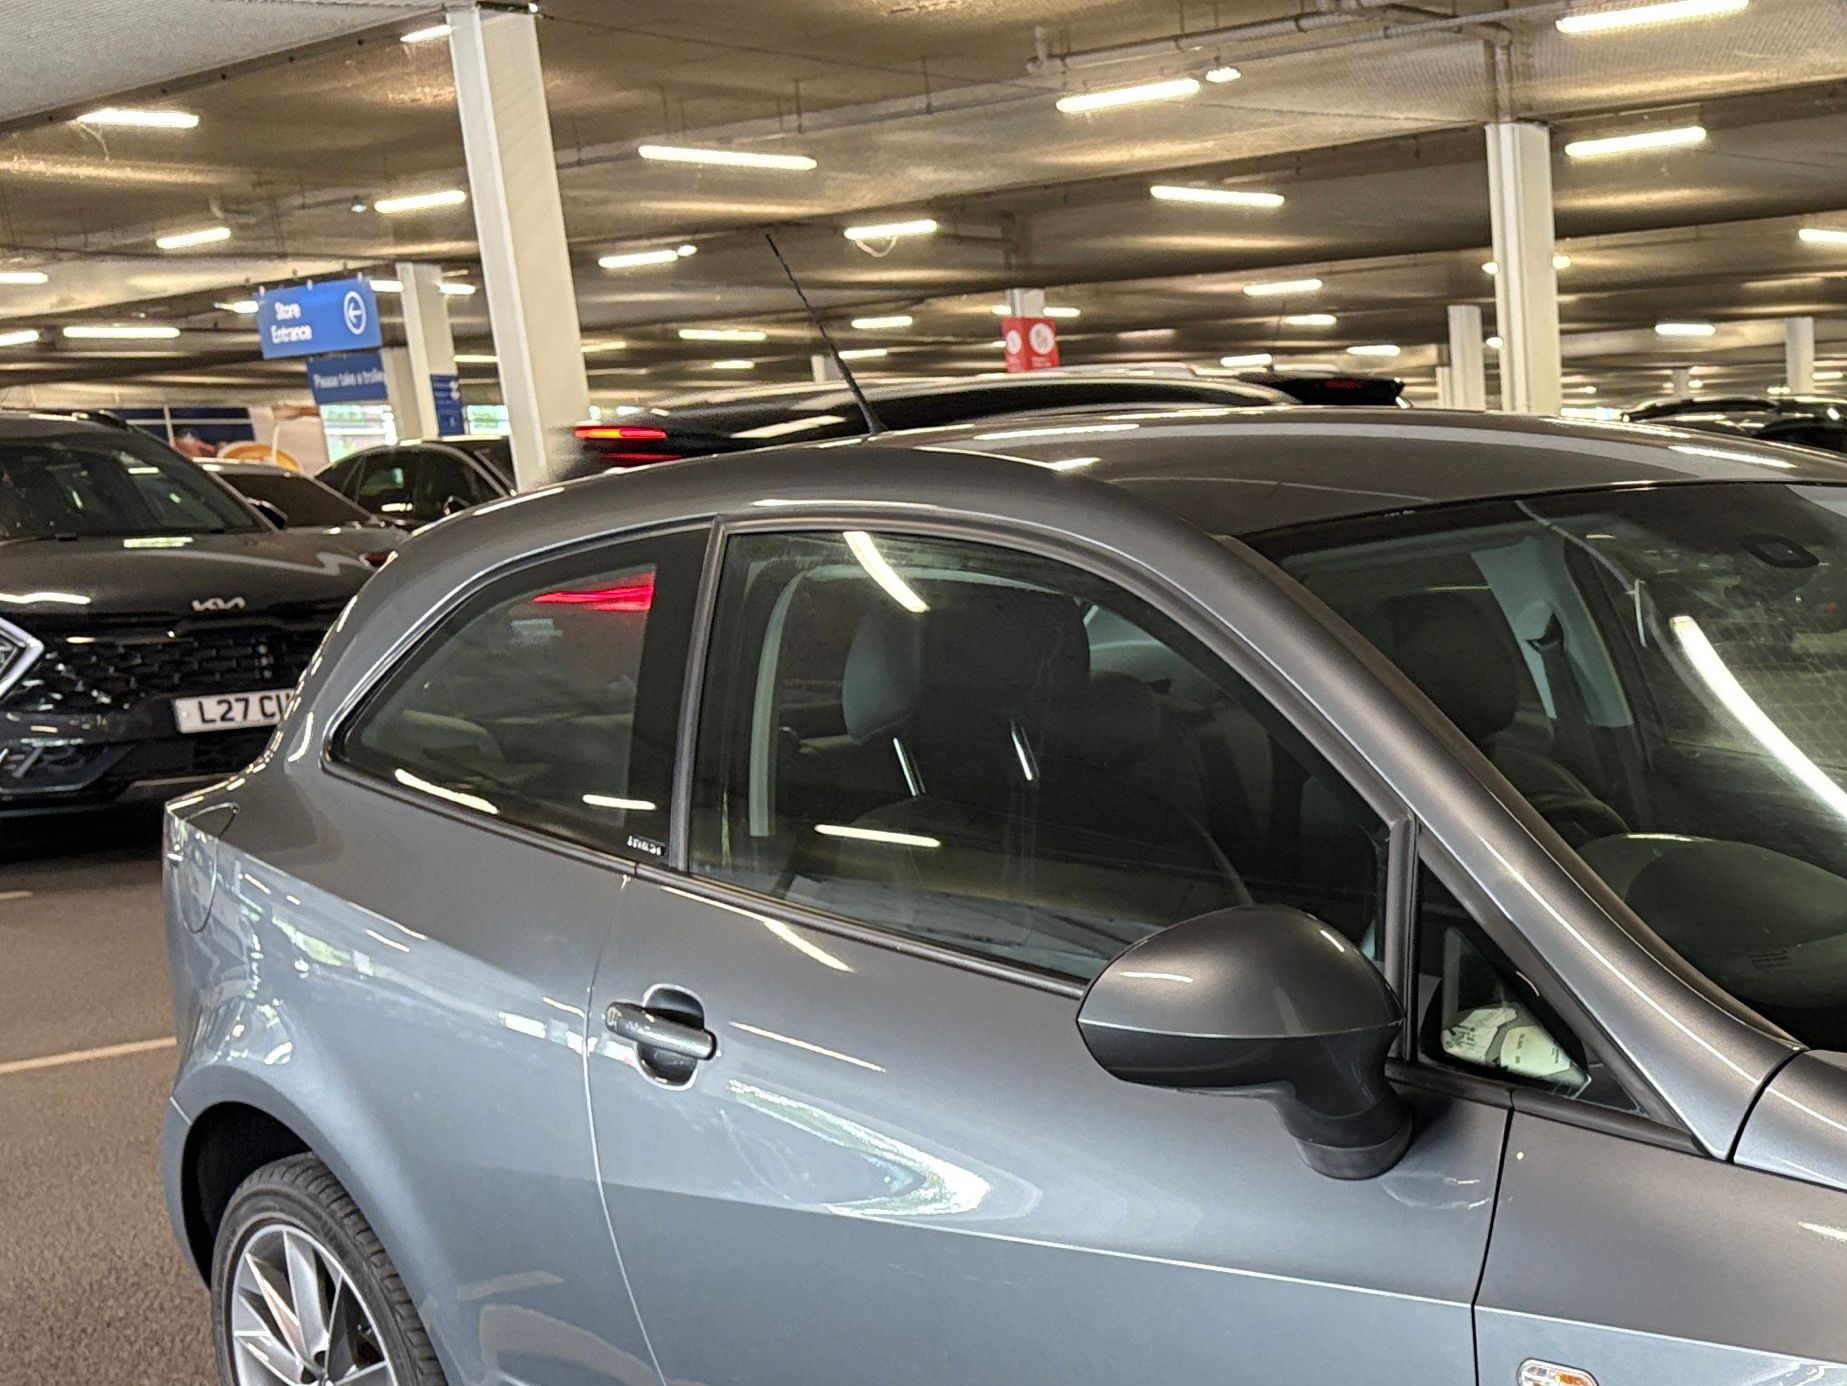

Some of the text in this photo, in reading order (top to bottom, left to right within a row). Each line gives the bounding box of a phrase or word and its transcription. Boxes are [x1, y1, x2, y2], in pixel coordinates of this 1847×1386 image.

[275, 302, 301, 320] Store
[271, 325, 312, 343] Entrance
[198, 697, 249, 723] L27
